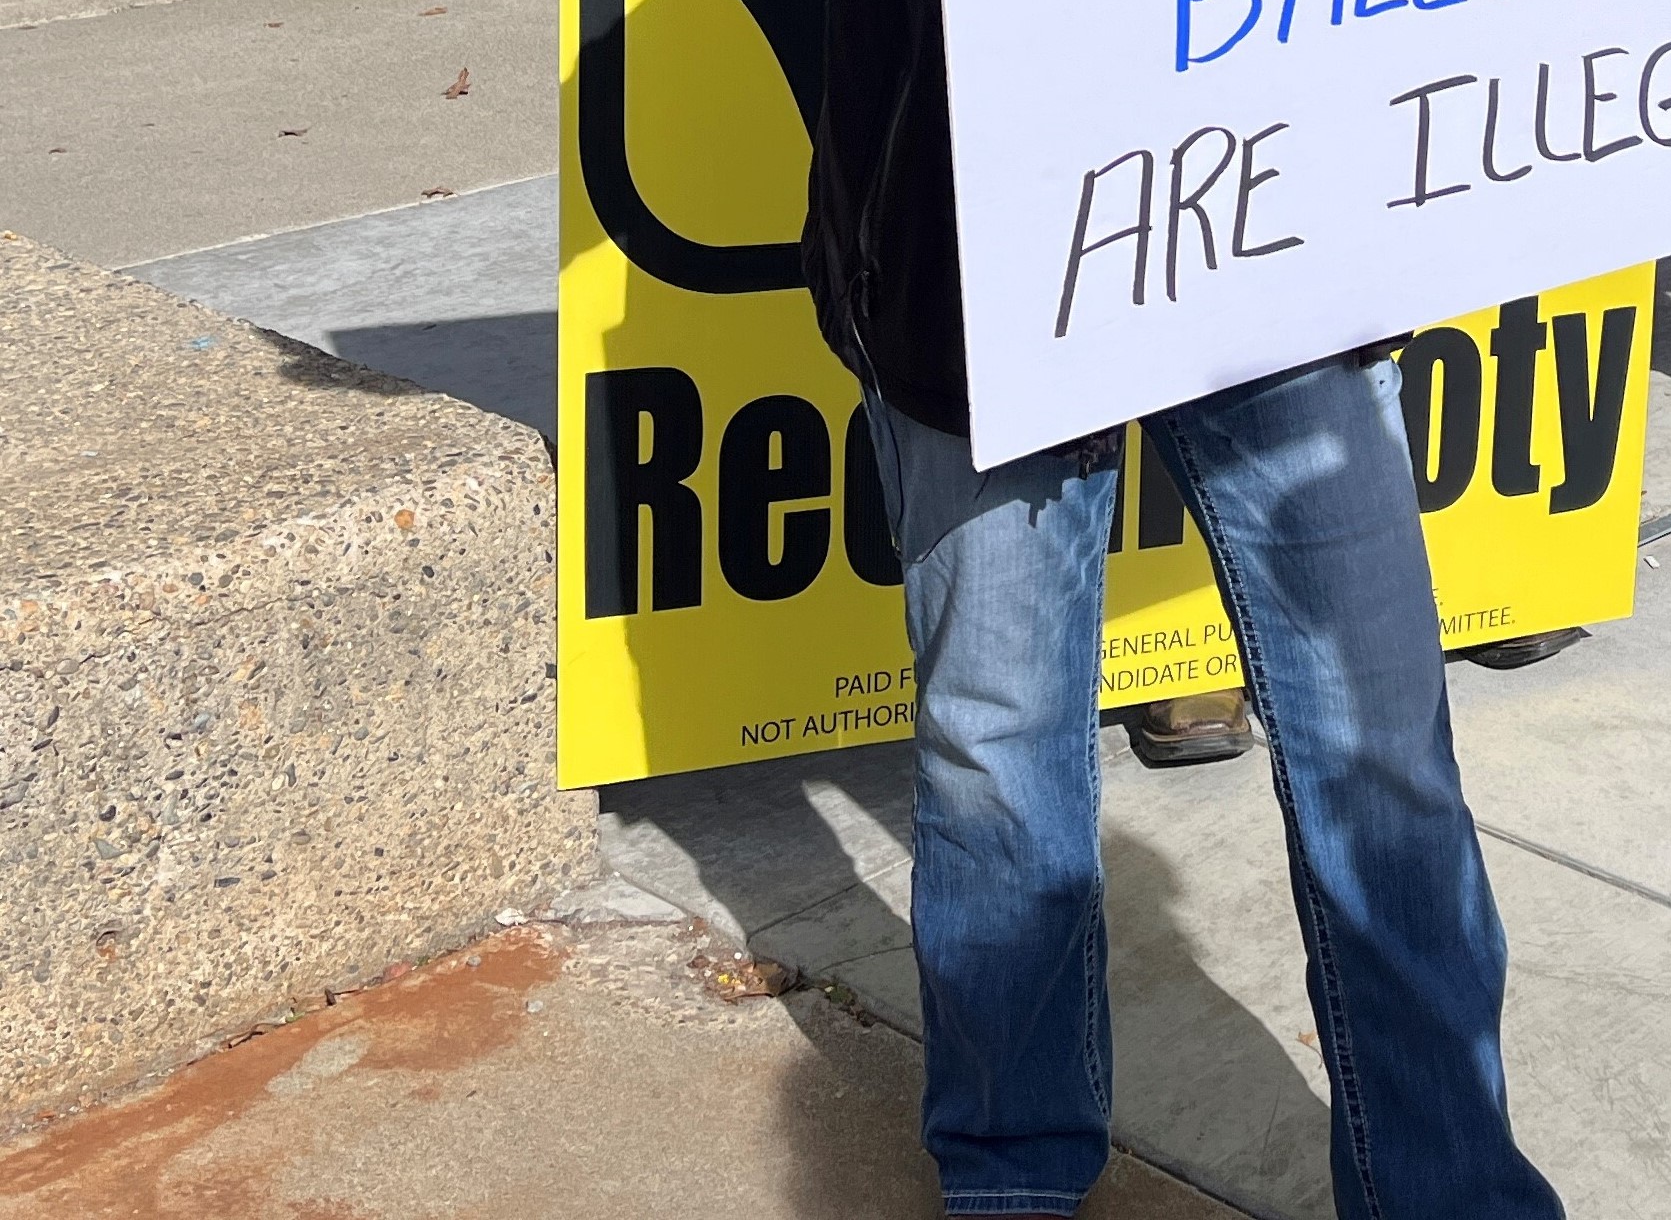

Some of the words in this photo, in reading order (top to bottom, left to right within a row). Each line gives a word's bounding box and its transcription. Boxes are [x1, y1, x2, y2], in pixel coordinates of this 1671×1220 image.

[1055, 123, 1304, 338] ARE
[741, 718, 796, 746] NOT
[802, 701, 915, 737] AUTHORI
[1100, 659, 1199, 694] NDIDATE
[1206, 653, 1237, 676] OR
[1440, 606, 1516, 635] MITTEE.
[835, 670, 892, 698] PAID
